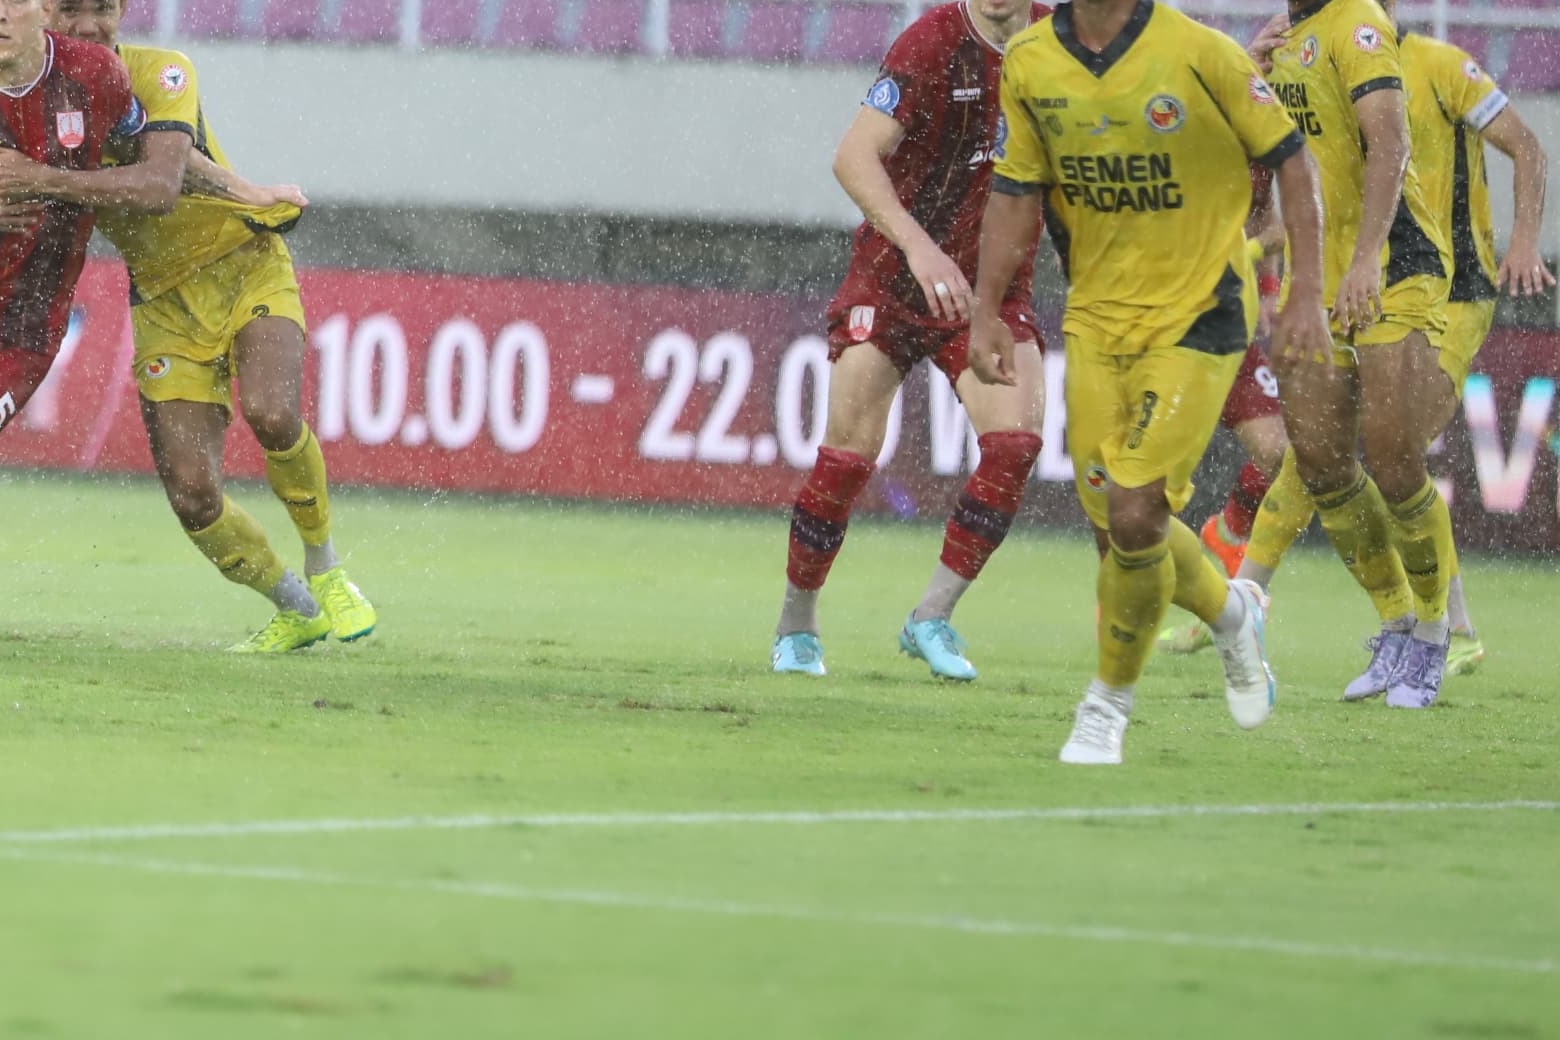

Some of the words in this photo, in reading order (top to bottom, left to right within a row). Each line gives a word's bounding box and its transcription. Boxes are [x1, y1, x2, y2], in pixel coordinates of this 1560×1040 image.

[1269, 81, 1309, 109] MEN
[1059, 153, 1172, 184] SEMEN
[1061, 182, 1184, 213] PADANG
[314, 313, 550, 453] 10.00
